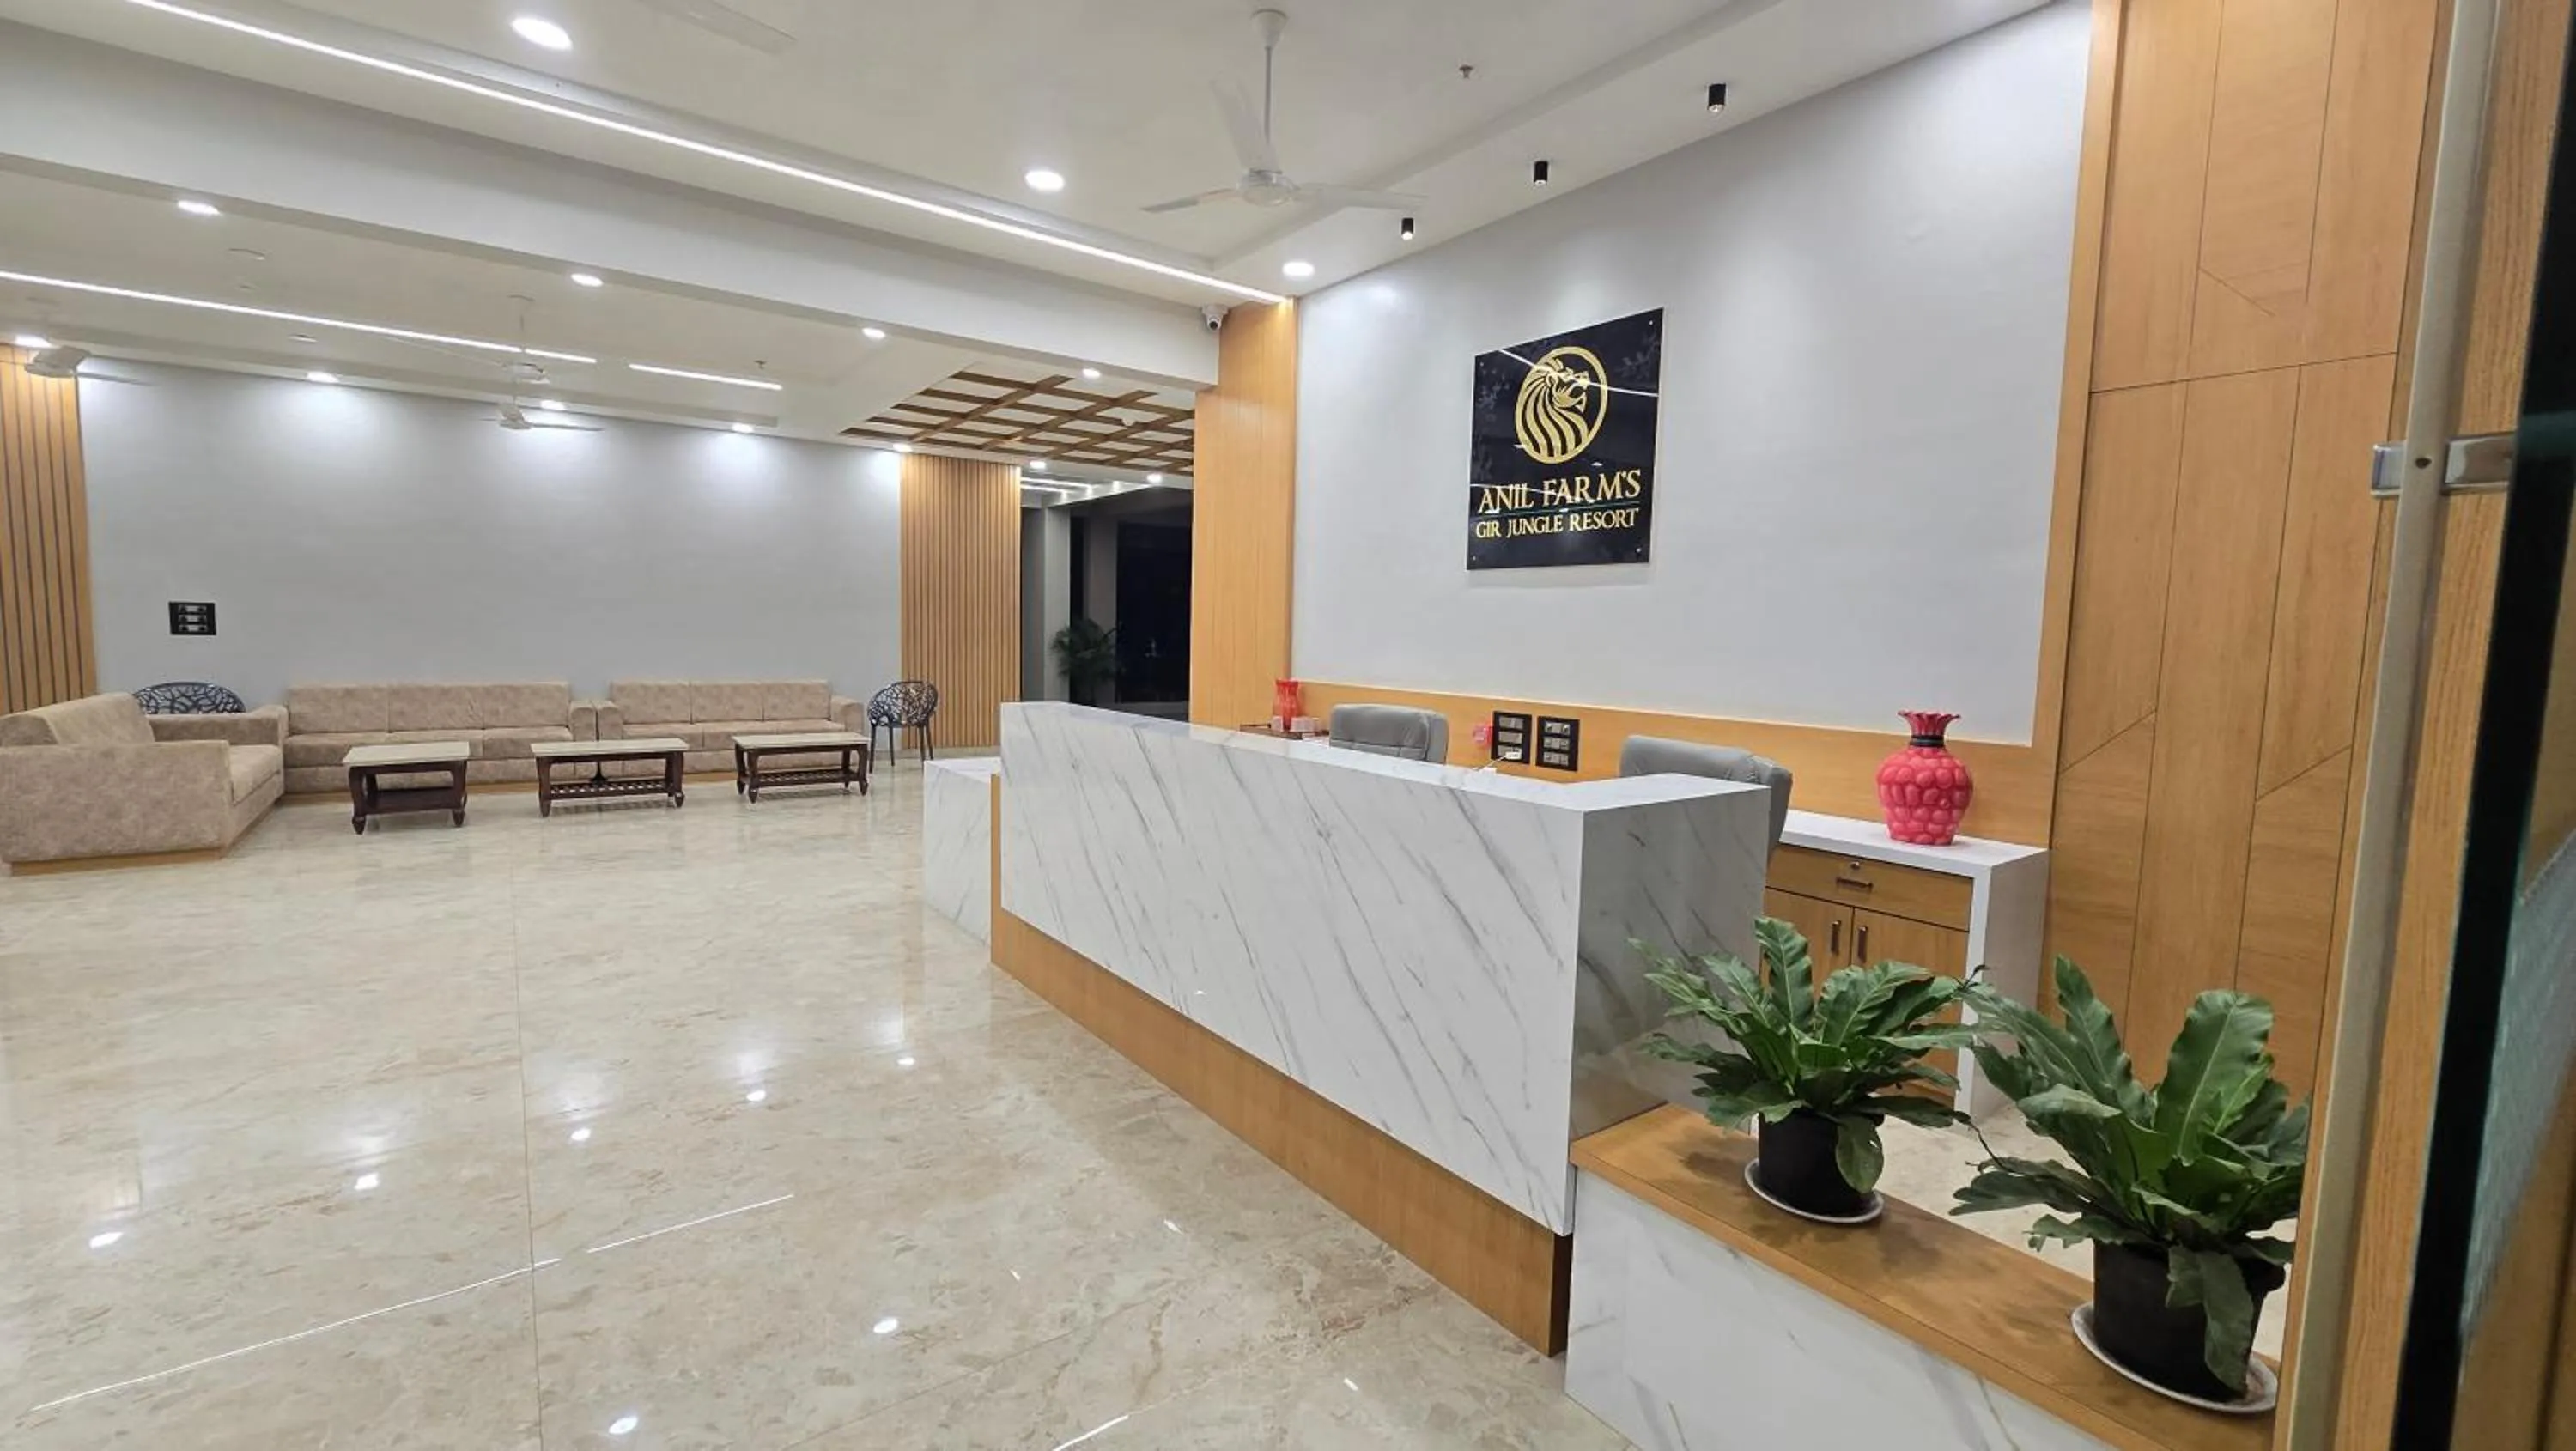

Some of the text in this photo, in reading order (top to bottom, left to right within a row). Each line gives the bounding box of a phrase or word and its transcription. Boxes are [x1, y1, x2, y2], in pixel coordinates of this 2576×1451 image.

[1478, 469, 1642, 513] ANIL FARM'S
[1476, 507, 1639, 538] GIR JUNGLE RESORT
